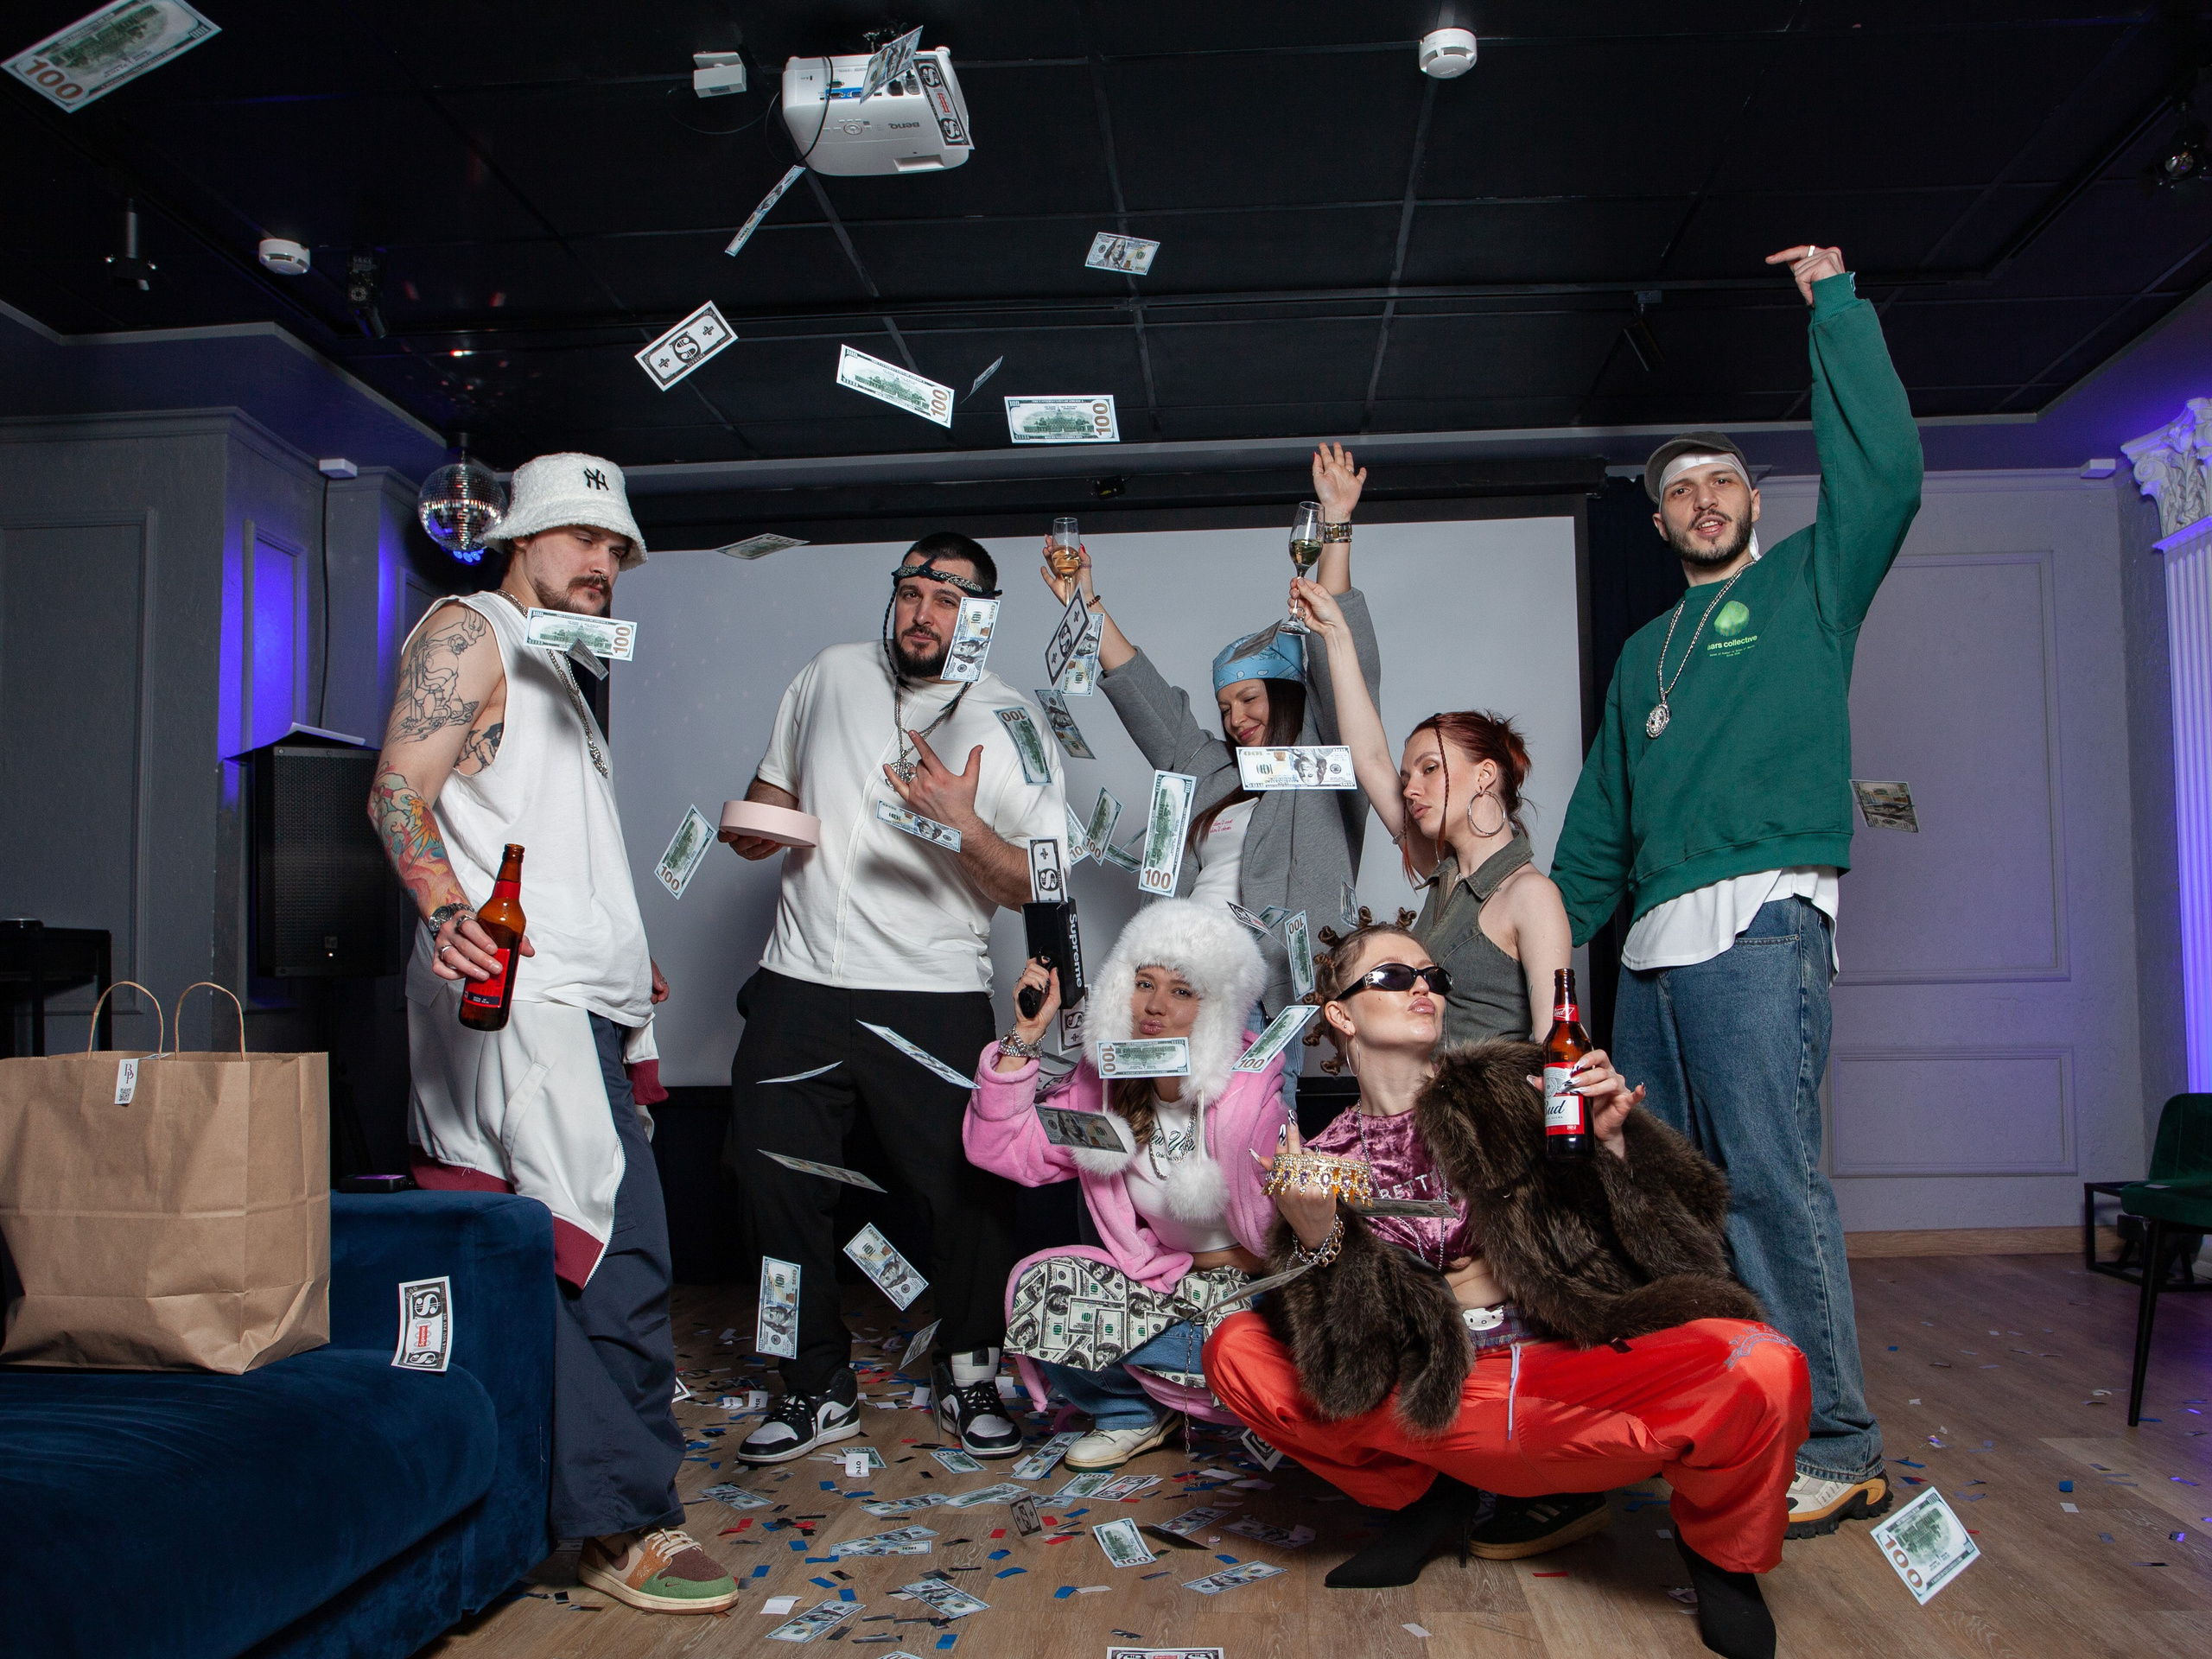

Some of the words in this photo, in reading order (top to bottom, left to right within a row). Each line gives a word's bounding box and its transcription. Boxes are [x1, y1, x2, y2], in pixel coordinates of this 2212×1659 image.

[23, 58, 84, 99] 100
[931, 389, 948, 417] 100
[1093, 403, 1112, 435] 100
[613, 626, 631, 654] 100
[1723, 635, 1758, 648] collective
[1001, 710, 1027, 722] 100
[1085, 836, 1102, 859] 100
[660, 866, 680, 891] 100
[1144, 868, 1171, 890] 100
[1288, 917, 1305, 935] 100
[1069, 912, 1083, 988] Supreme
[1101, 1044, 1116, 1073] 100
[1238, 1058, 1265, 1070] 100
[1118, 1555, 1150, 1565] 100
[1885, 1534, 1923, 1588] 100
